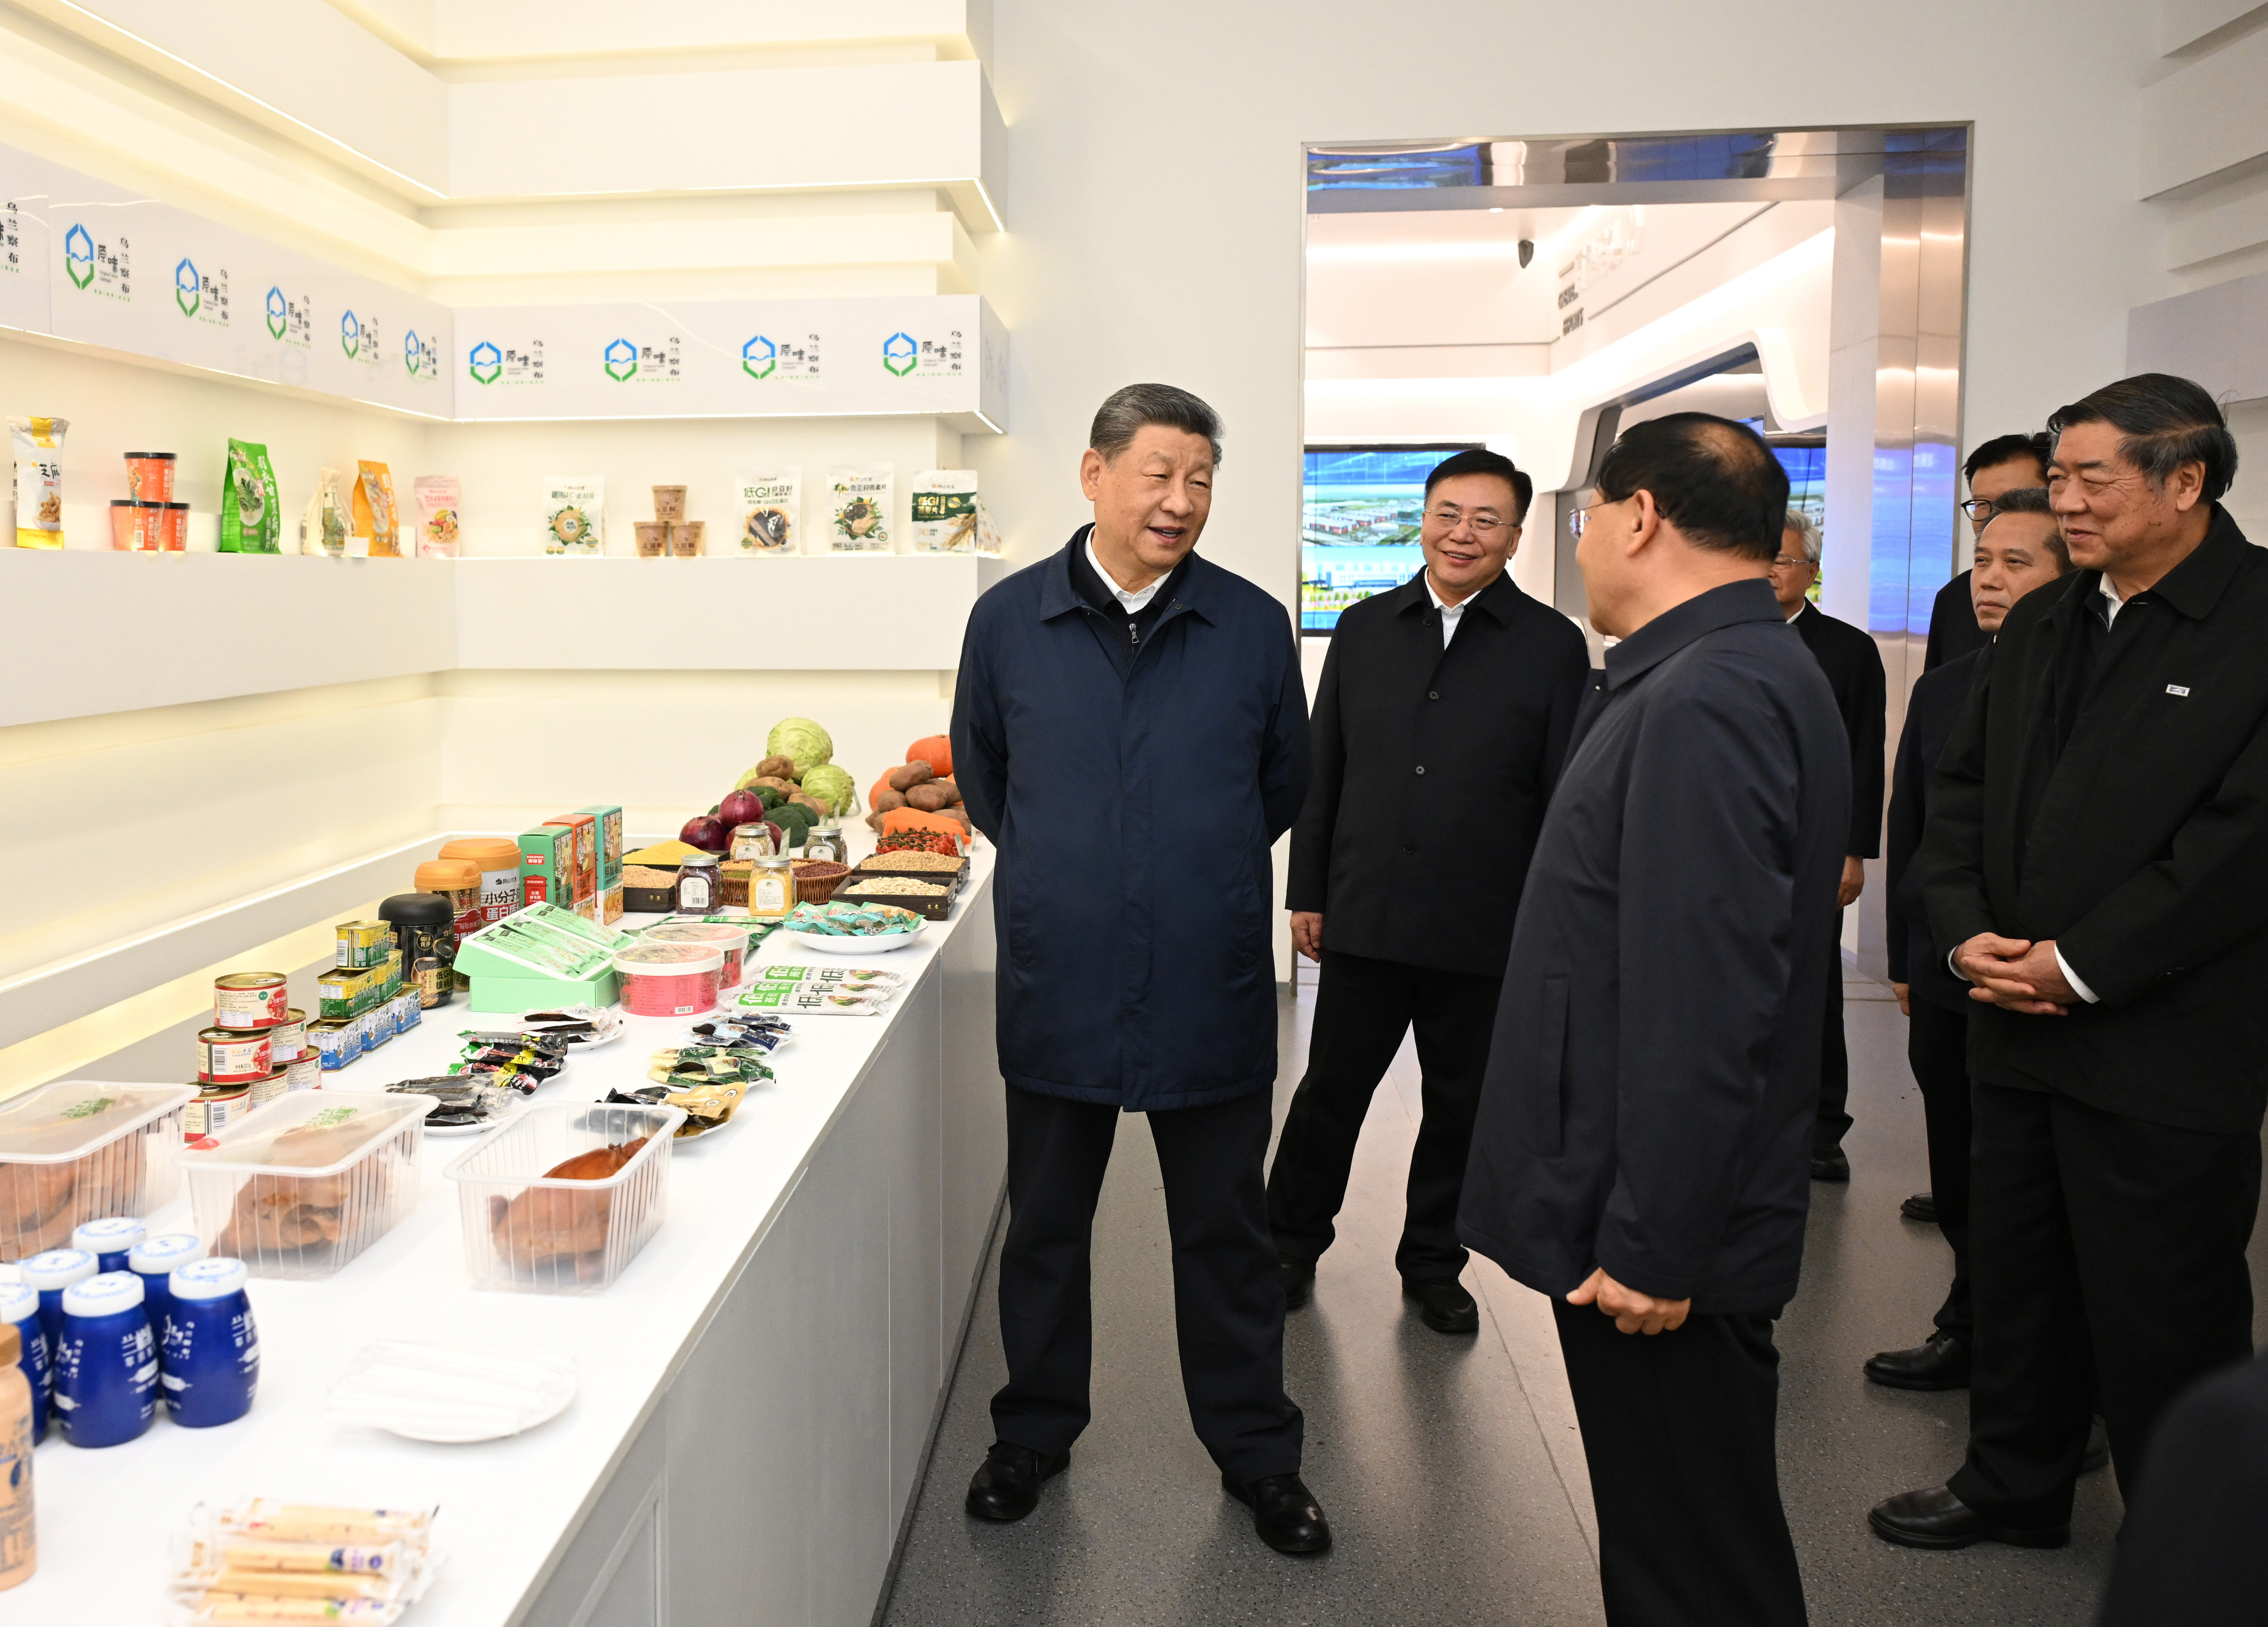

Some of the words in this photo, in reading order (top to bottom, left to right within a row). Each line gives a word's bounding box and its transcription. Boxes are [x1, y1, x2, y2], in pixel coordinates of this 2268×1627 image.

[7, 202, 18, 263] 乌兰察布
[98, 244, 118, 273] 原味
[120, 237, 130, 294] 乌兰察布
[202, 276, 218, 302] 原味
[641, 347, 666, 364] 原味
[780, 344, 805, 361] 原味
[922, 341, 947, 358] 原味
[950, 330, 962, 370] 乌兰察布
[506, 350, 530, 367] 原味
[743, 487, 770, 498] 低GI
[918, 496, 939, 506] 低GI
[820, 970, 845, 983] 低
[797, 996, 824, 1009] 低
